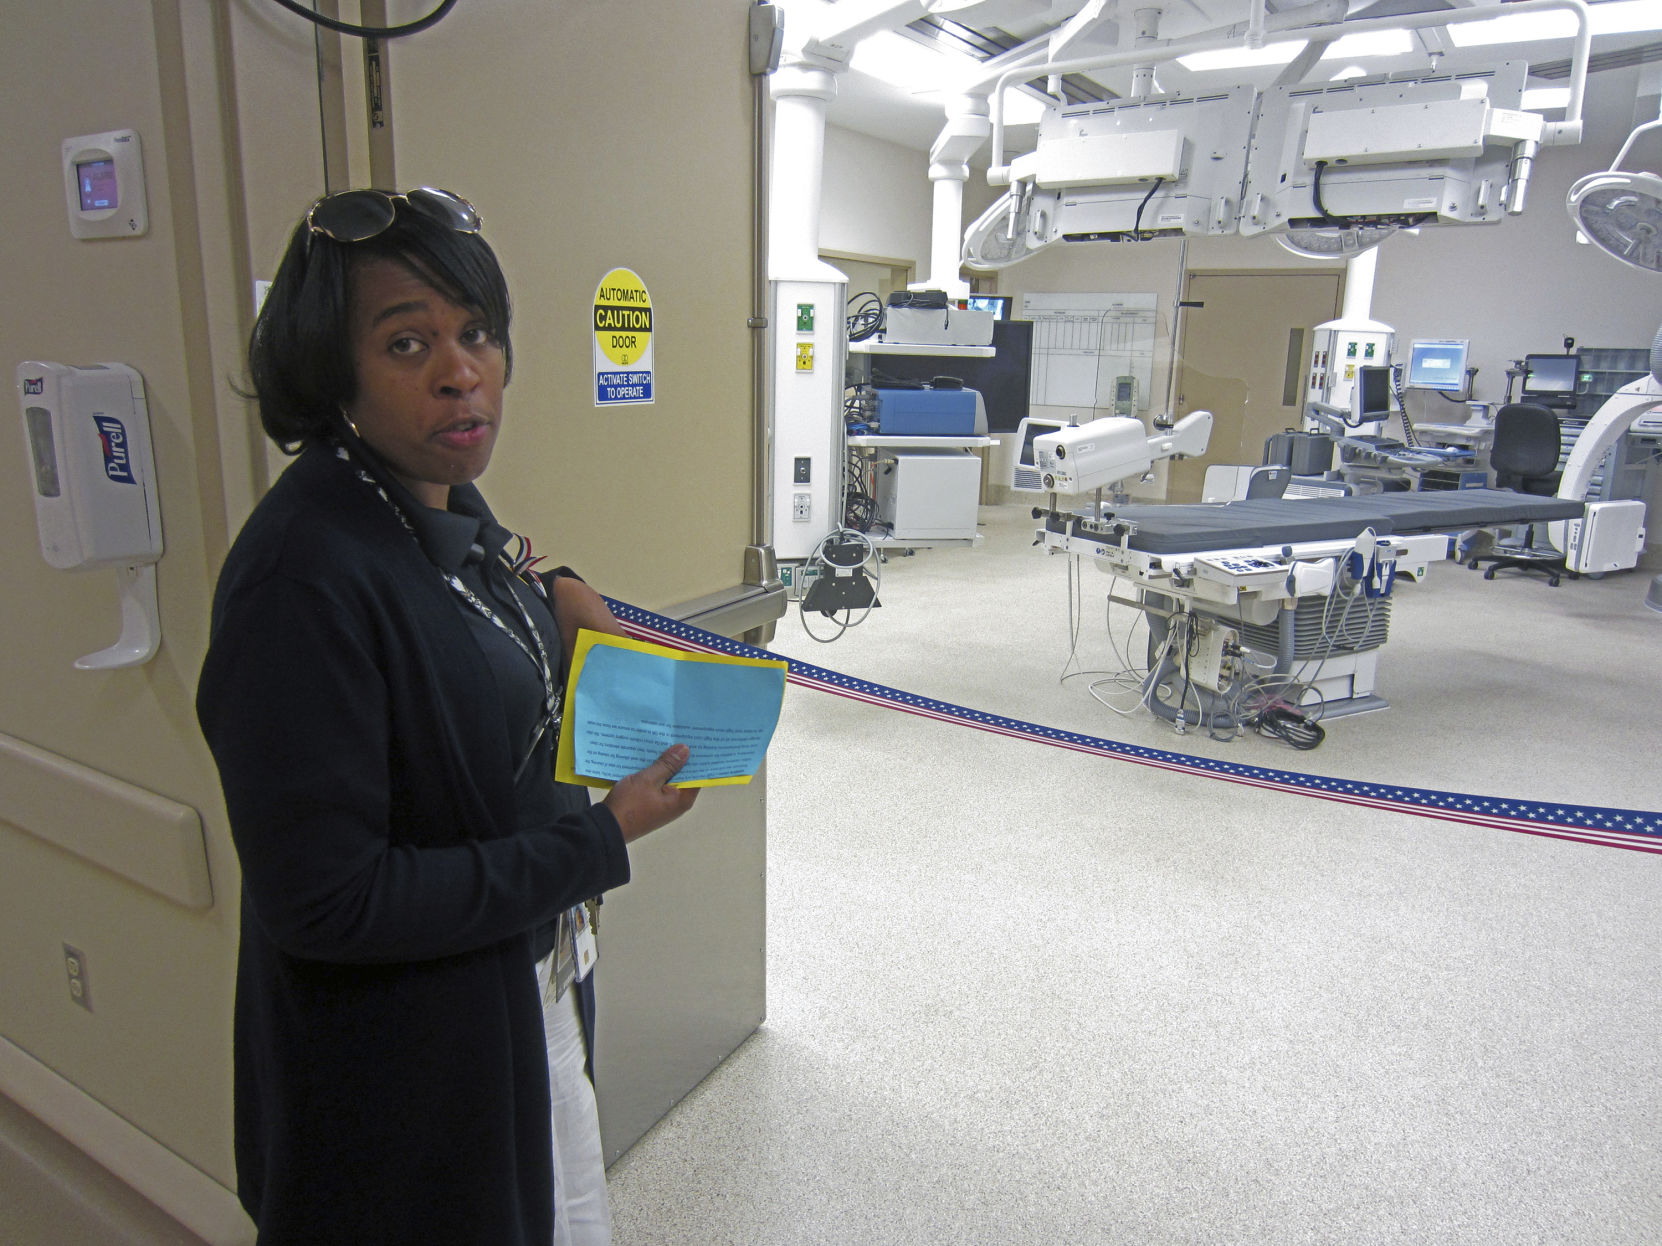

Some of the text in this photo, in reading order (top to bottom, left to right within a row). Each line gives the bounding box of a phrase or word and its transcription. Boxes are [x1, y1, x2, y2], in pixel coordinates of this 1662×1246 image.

[599, 288, 647, 303] AUTOMATIC
[596, 309, 650, 328] CAUTION
[611, 335, 637, 349] DOOR
[599, 373, 650, 385] ACTIVATE SWITCH
[607, 386, 643, 398] TO OPERATE
[102, 422, 128, 477] Purell
